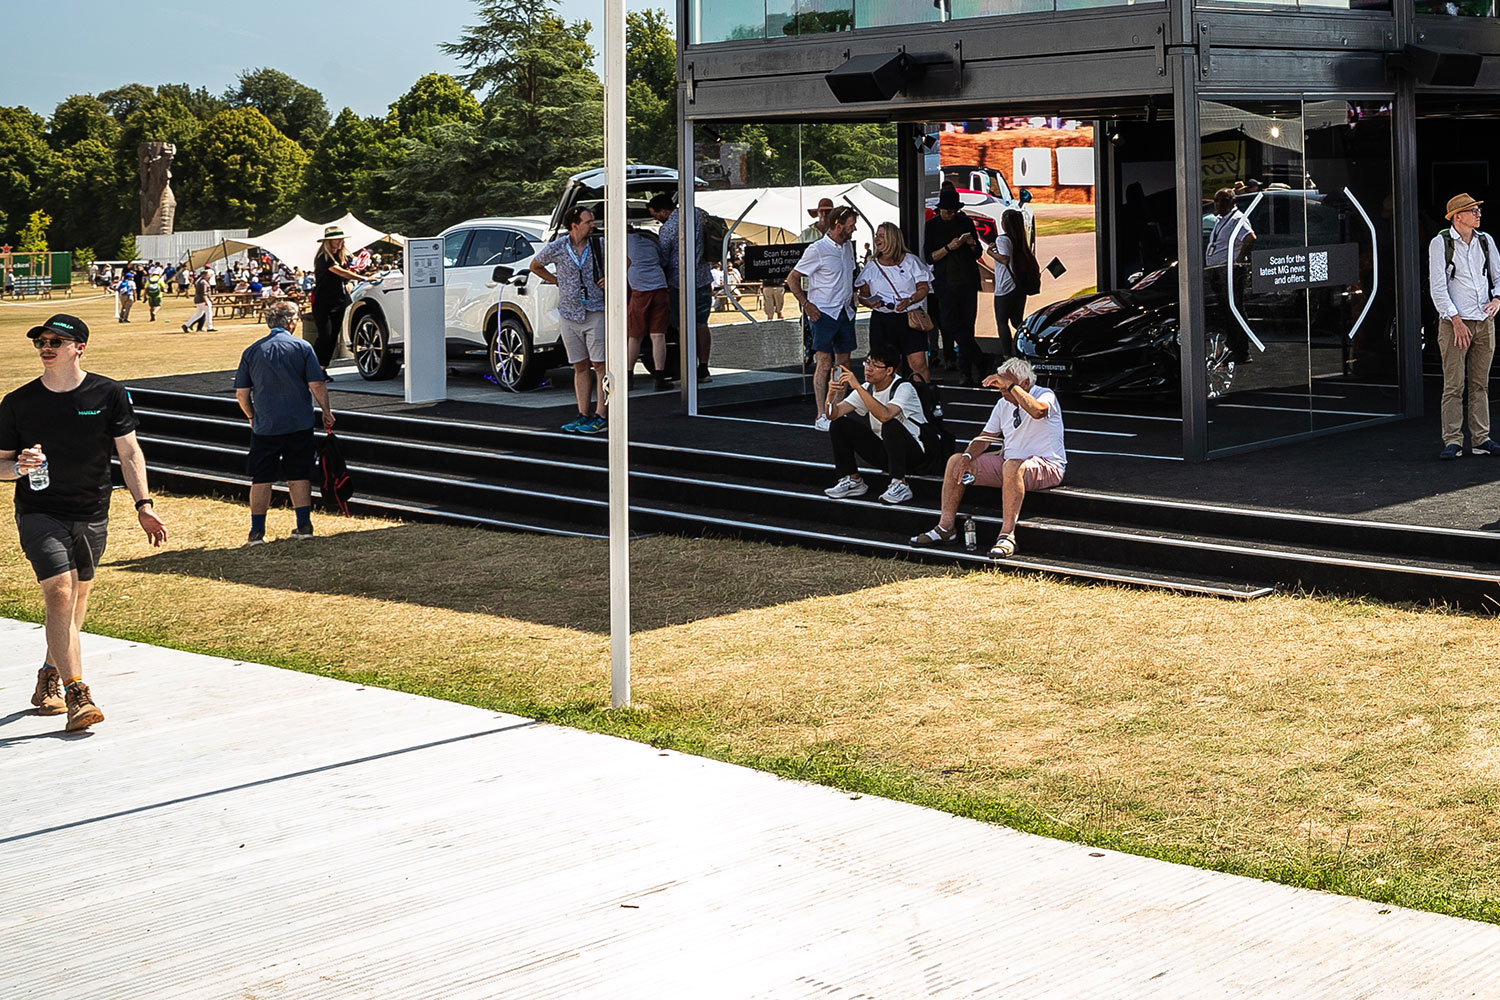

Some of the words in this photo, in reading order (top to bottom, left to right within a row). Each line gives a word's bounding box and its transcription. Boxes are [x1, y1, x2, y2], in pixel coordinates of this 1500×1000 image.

[764, 250, 780, 258] Scan
[771, 258, 784, 266] MG
[1270, 256, 1286, 265] Scan
[1286, 255, 1294, 263] for
[1296, 254, 1305, 263] the
[768, 266, 780, 274] and
[1260, 267, 1277, 276] latest
[1278, 265, 1289, 274] MG
[1274, 275, 1286, 285] and
[1287, 274, 1306, 283] offers.
